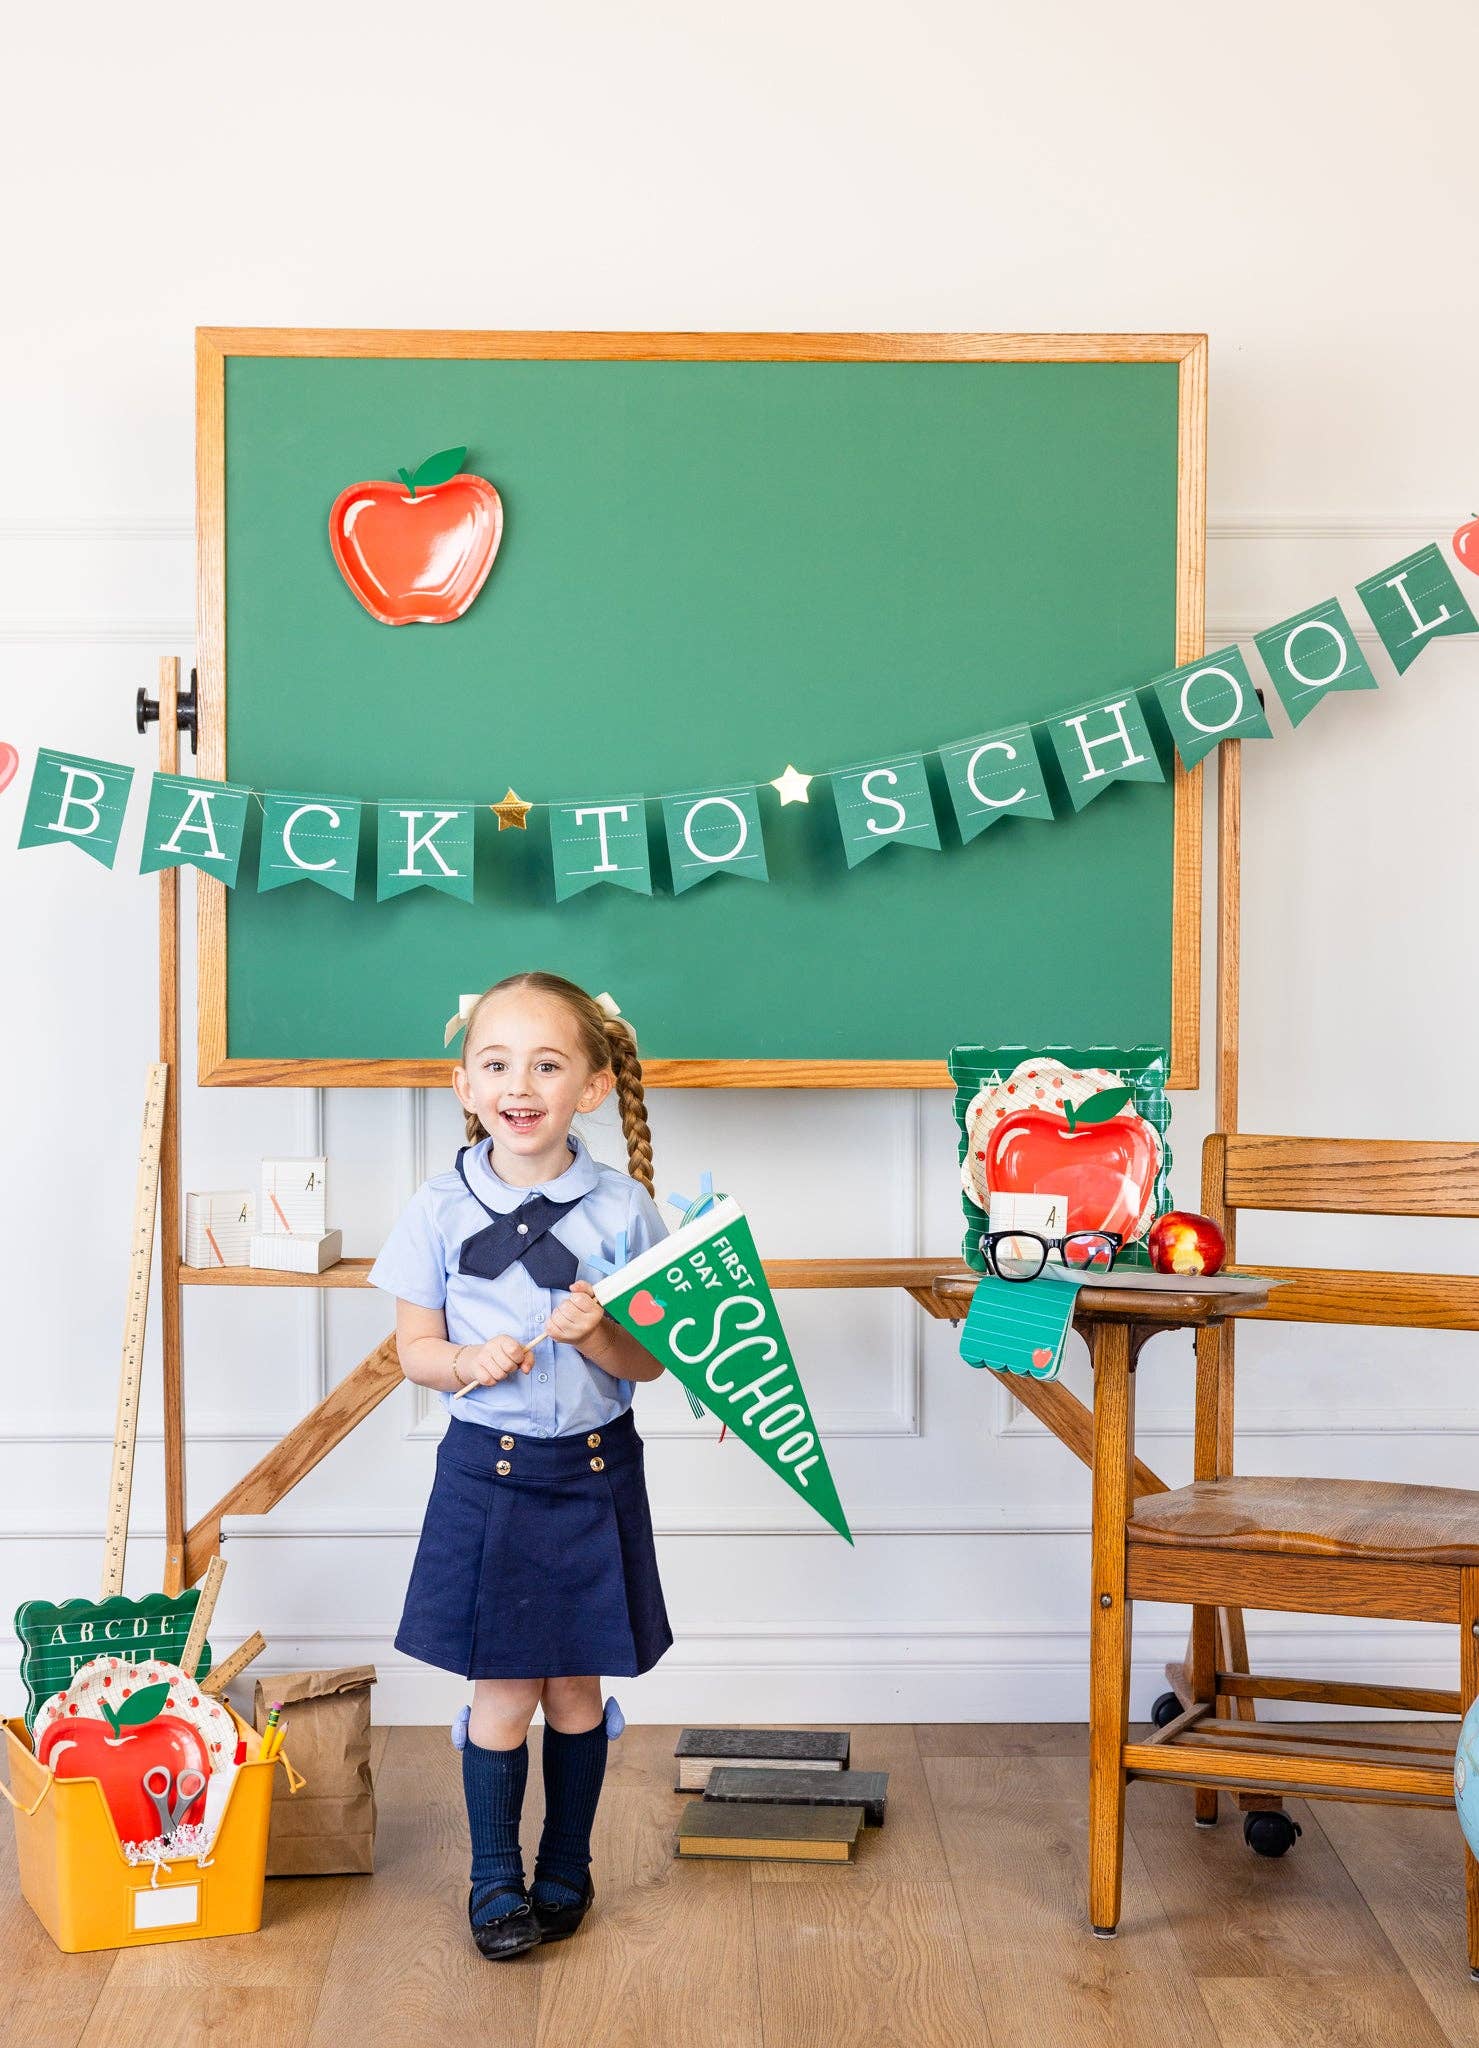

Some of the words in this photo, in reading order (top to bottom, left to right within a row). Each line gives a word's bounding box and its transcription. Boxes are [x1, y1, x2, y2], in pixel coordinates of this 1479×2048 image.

[47, 765, 459, 877] BACK
[575, 795, 748, 873] TO
[859, 572, 1450, 836] SCHOOL
[666, 1267, 692, 1294] OF
[689, 1250, 723, 1291] DAY
[712, 1236, 756, 1290] FIRST
[668, 1295, 820, 1487] SCHOOL
